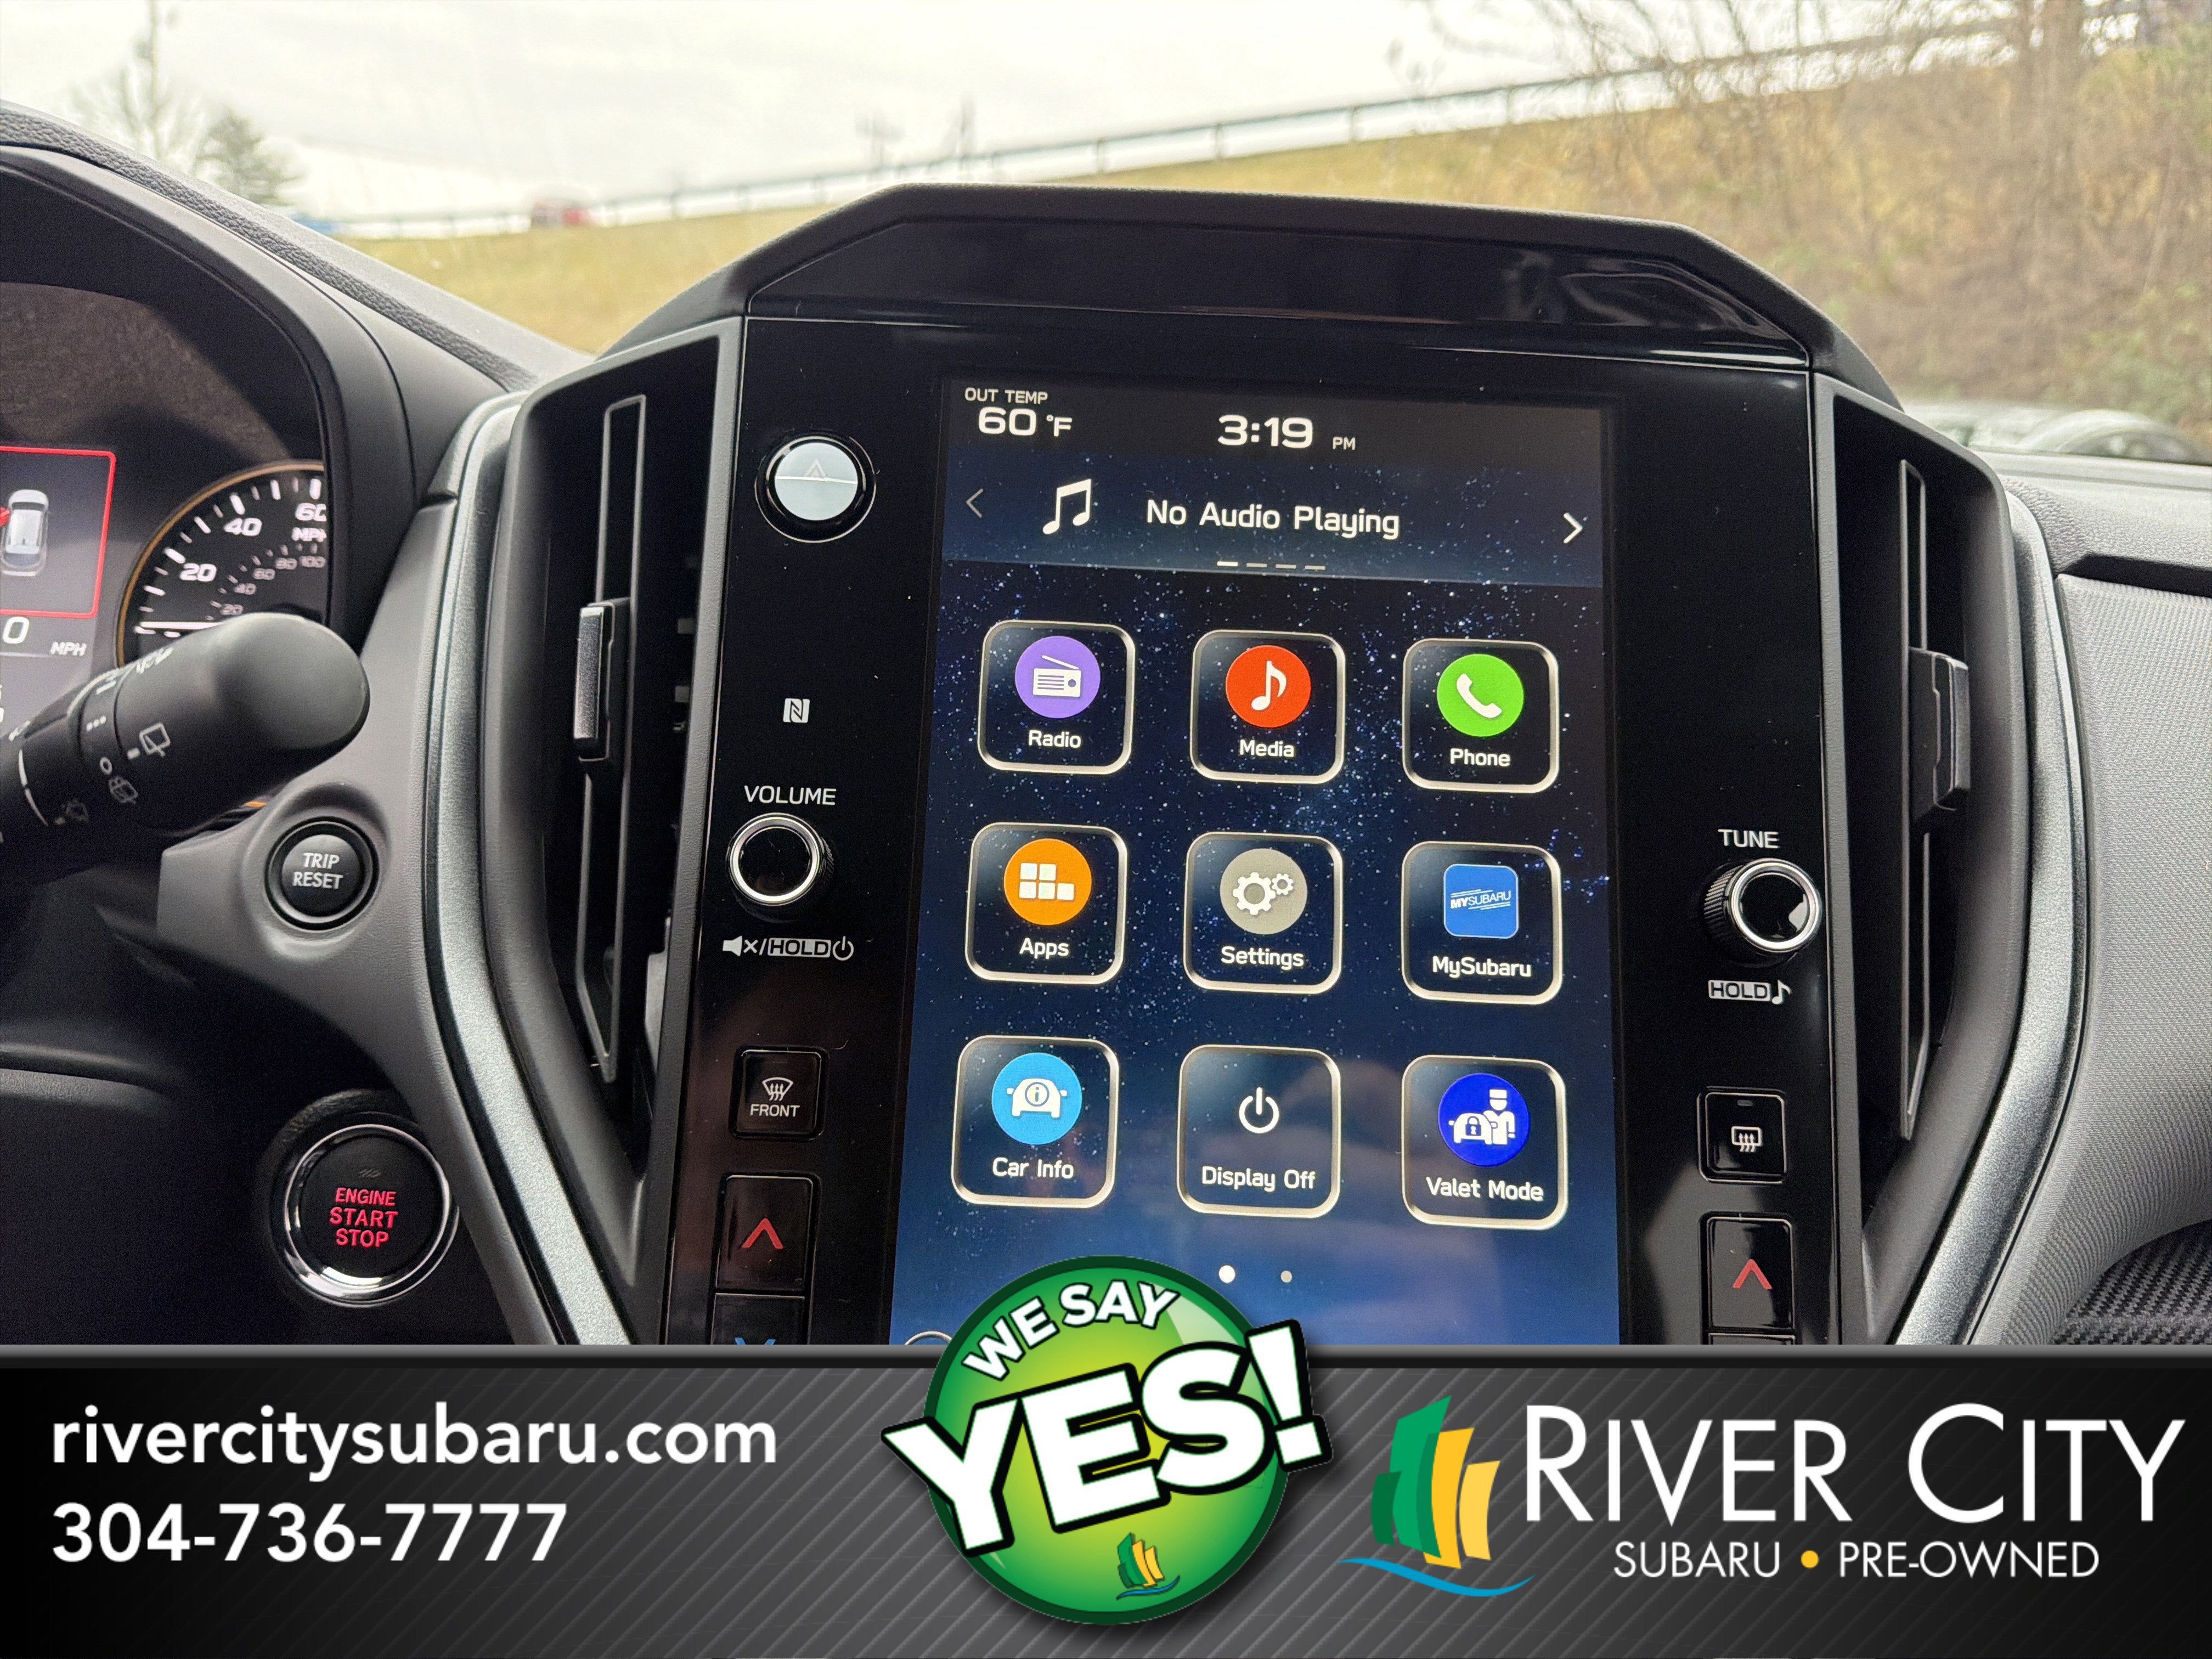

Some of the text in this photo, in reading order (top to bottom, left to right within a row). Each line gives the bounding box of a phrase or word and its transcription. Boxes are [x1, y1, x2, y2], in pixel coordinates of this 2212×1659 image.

[964, 387, 1048, 405] OUT TEMP
[978, 407, 1036, 436] 60
[1217, 414, 1356, 450] 3:19 PM
[223, 517, 262, 537] 40
[1147, 499, 1400, 540] No Audio Playing
[180, 563, 217, 582] 20
[234, 583, 257, 595] 40
[3, 616, 29, 644] 0
[1028, 730, 1081, 748] Radio
[1239, 739, 1295, 758] Media
[1449, 748, 1511, 767] Phone
[744, 785, 837, 805] VOLUME
[1717, 828, 1780, 849] TUNE
[303, 852, 340, 869] TRIP
[292, 871, 344, 889] RESET
[1019, 938, 1069, 960] Apps
[1221, 946, 1304, 970] Settings
[1432, 955, 1532, 978] MySubaru
[1708, 980, 1773, 1001] HOLD
[749, 1103, 800, 1118] FRONT
[992, 1156, 1075, 1180] Car Info
[1201, 1166, 1317, 1192] Display Off
[1425, 1176, 1544, 1201] Valet Mode
[335, 1187, 397, 1206] ENGINE
[329, 1206, 399, 1229] START
[335, 1228, 390, 1248] STOP
